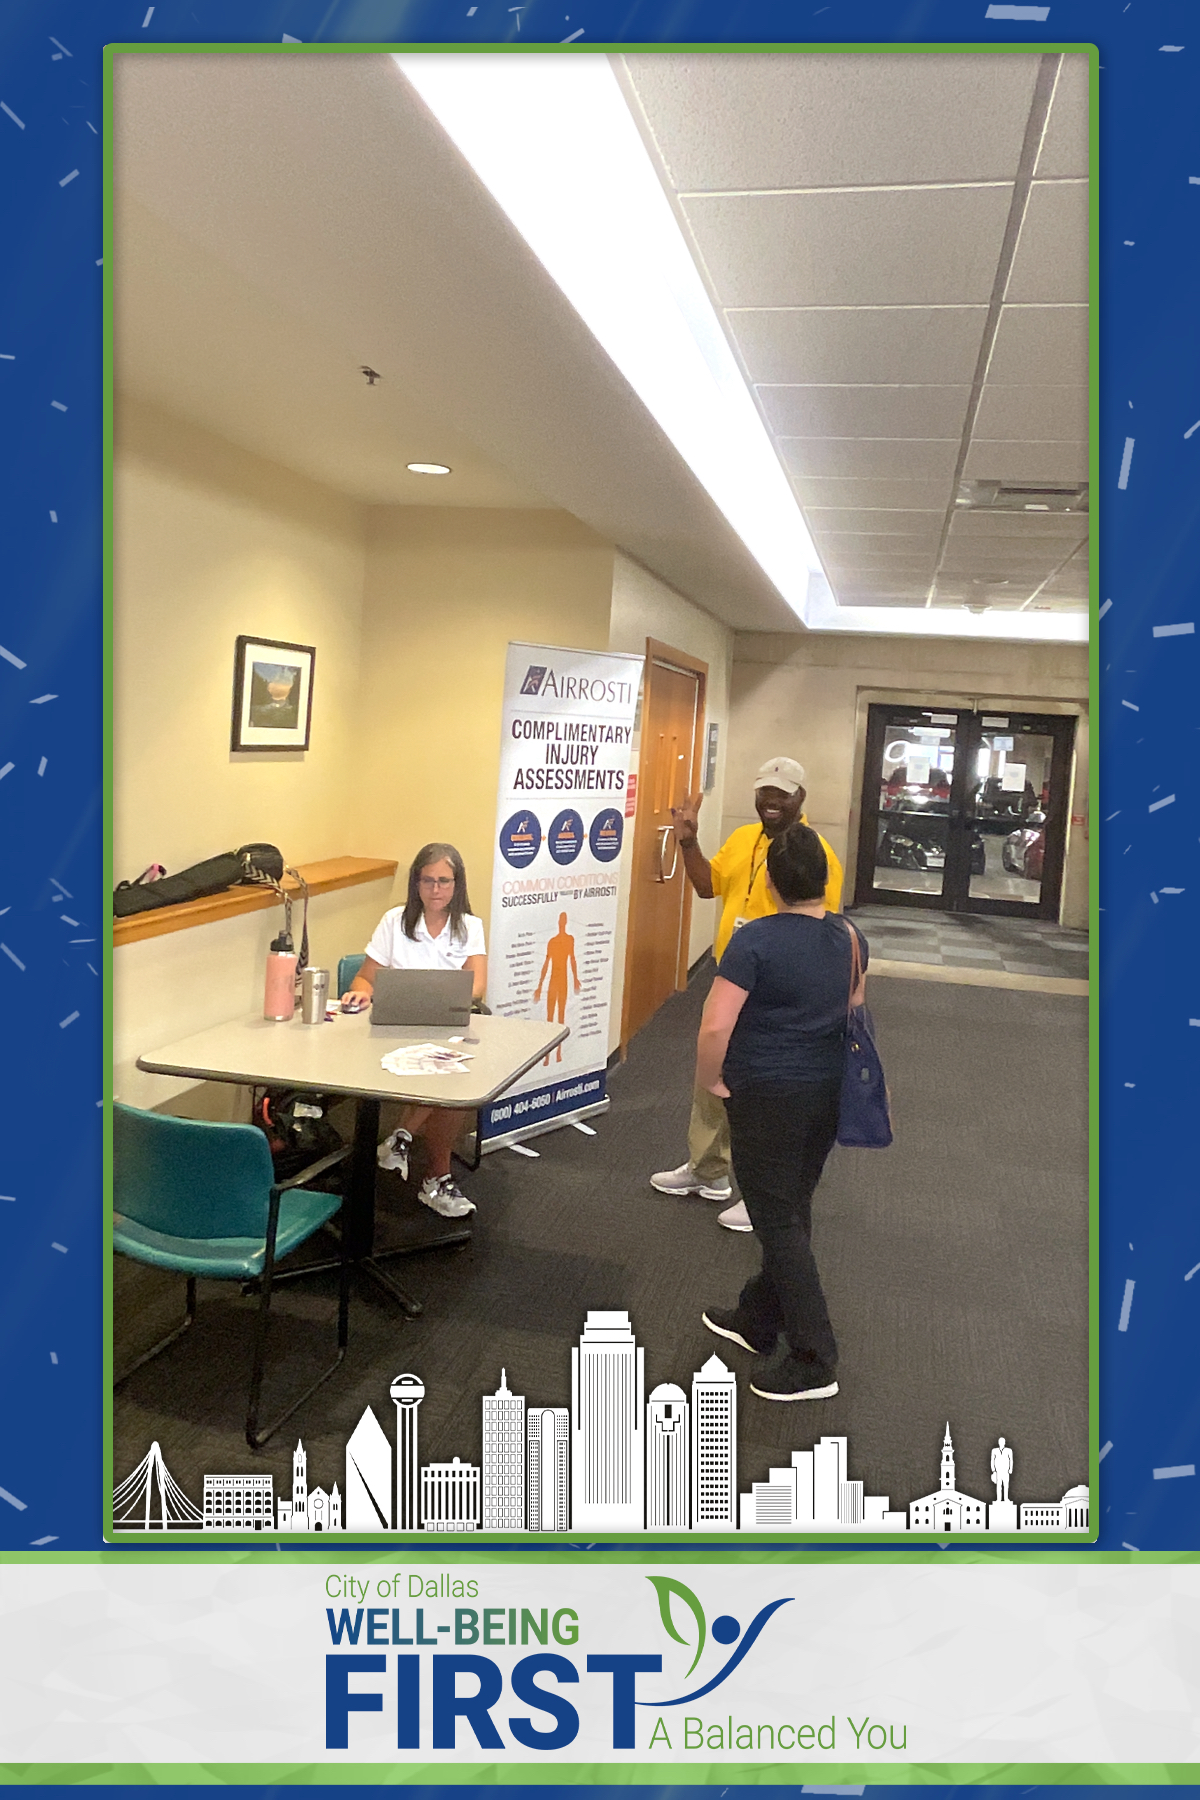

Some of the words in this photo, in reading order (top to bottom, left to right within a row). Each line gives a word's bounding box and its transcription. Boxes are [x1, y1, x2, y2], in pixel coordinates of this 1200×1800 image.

[541, 669, 632, 704] AIRROSTI
[512, 719, 632, 744] COMPLIMENTARY
[545, 743, 599, 765] INJURY
[513, 768, 625, 790] ASSESSMENTS
[502, 877, 554, 895] COMMON
[556, 872, 619, 890] CONDITIONS
[502, 891, 559, 908] SUCCESSFULLY
[573, 889, 583, 900] BY
[583, 886, 617, 898] AIRROSTI
[491, 1104, 512, 1123] (800)
[555, 1080, 600, 1102] Airrosti.com
